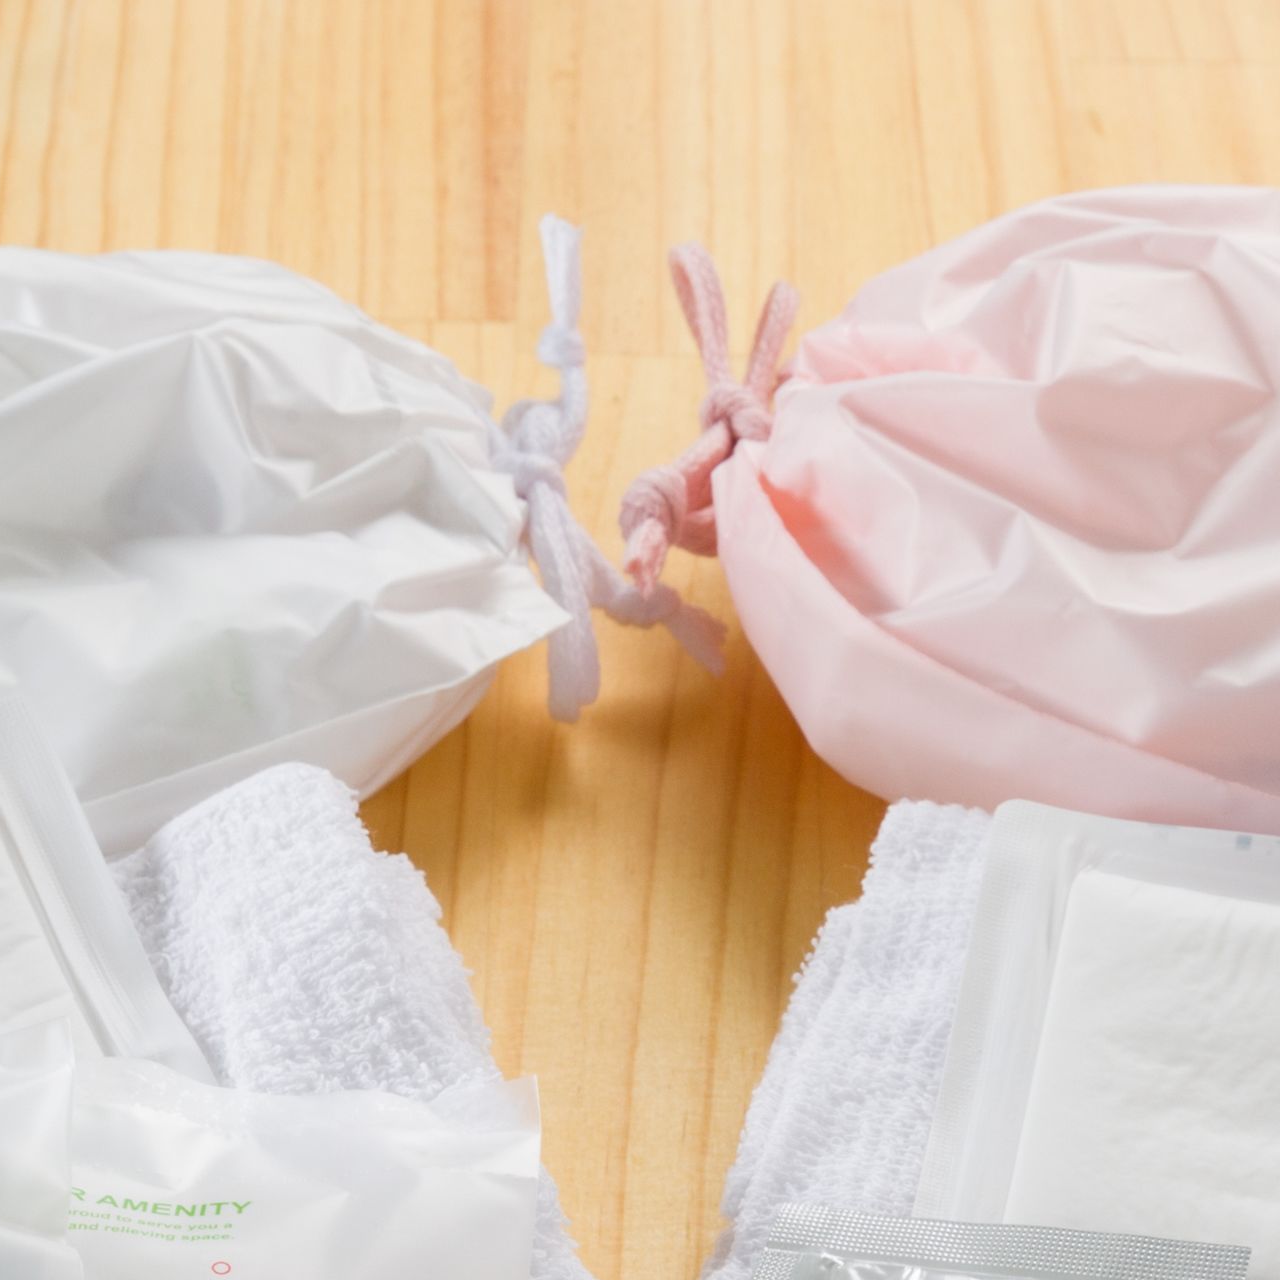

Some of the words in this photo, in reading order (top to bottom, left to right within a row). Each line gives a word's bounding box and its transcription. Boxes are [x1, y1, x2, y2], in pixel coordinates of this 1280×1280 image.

[96, 1194, 252, 1217] AMENITY
[117, 1214, 132, 1222] to
[137, 1218, 182, 1230] serve
[188, 1223, 219, 1232] you
[104, 1224, 176, 1241] relieving
